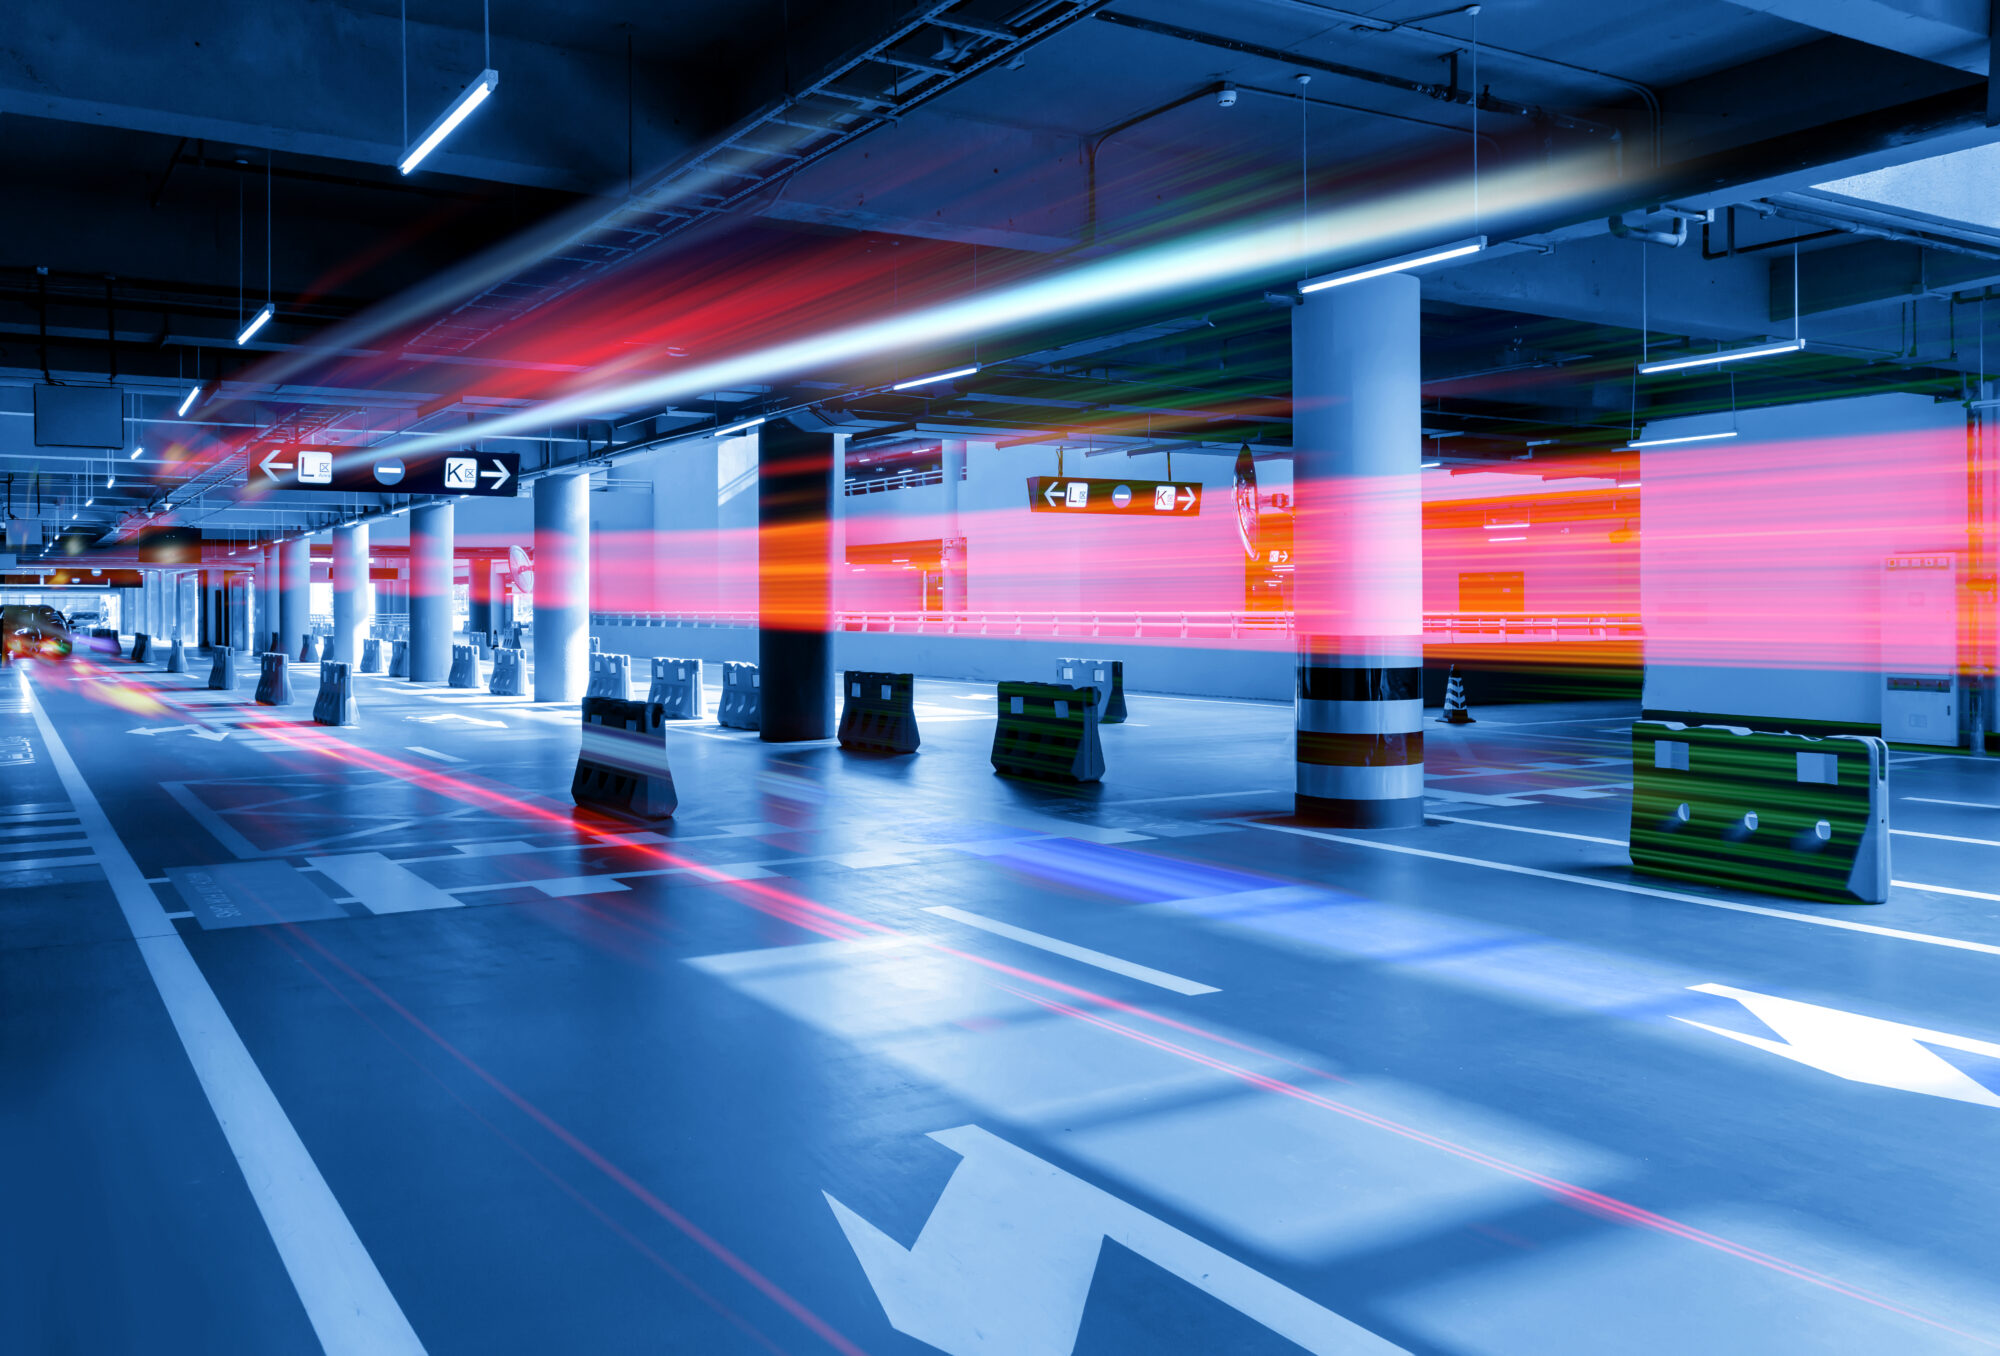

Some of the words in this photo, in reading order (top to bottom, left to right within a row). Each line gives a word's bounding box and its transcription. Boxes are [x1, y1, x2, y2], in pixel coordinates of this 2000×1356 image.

[301, 457, 314, 477] L
[447, 463, 463, 483] K
[1069, 487, 1077, 502] L
[1156, 490, 1167, 505] K
